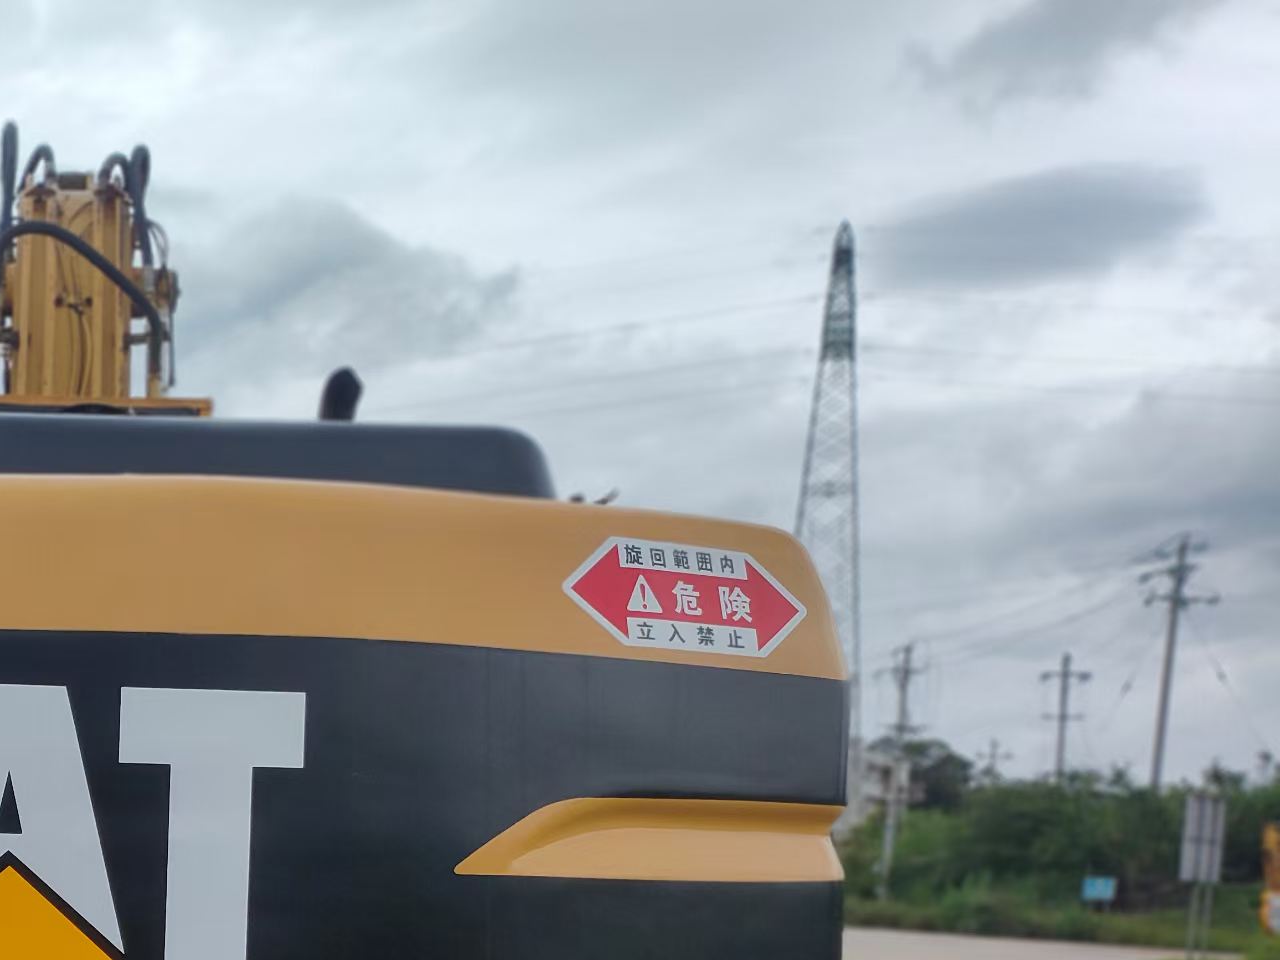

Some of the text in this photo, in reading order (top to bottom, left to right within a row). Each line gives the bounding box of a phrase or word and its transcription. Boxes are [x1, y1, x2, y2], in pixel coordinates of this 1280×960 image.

[623, 544, 735, 574] 旋回範囲内
[671, 580, 753, 623] 危険
[636, 621, 746, 649] 立入禁止
